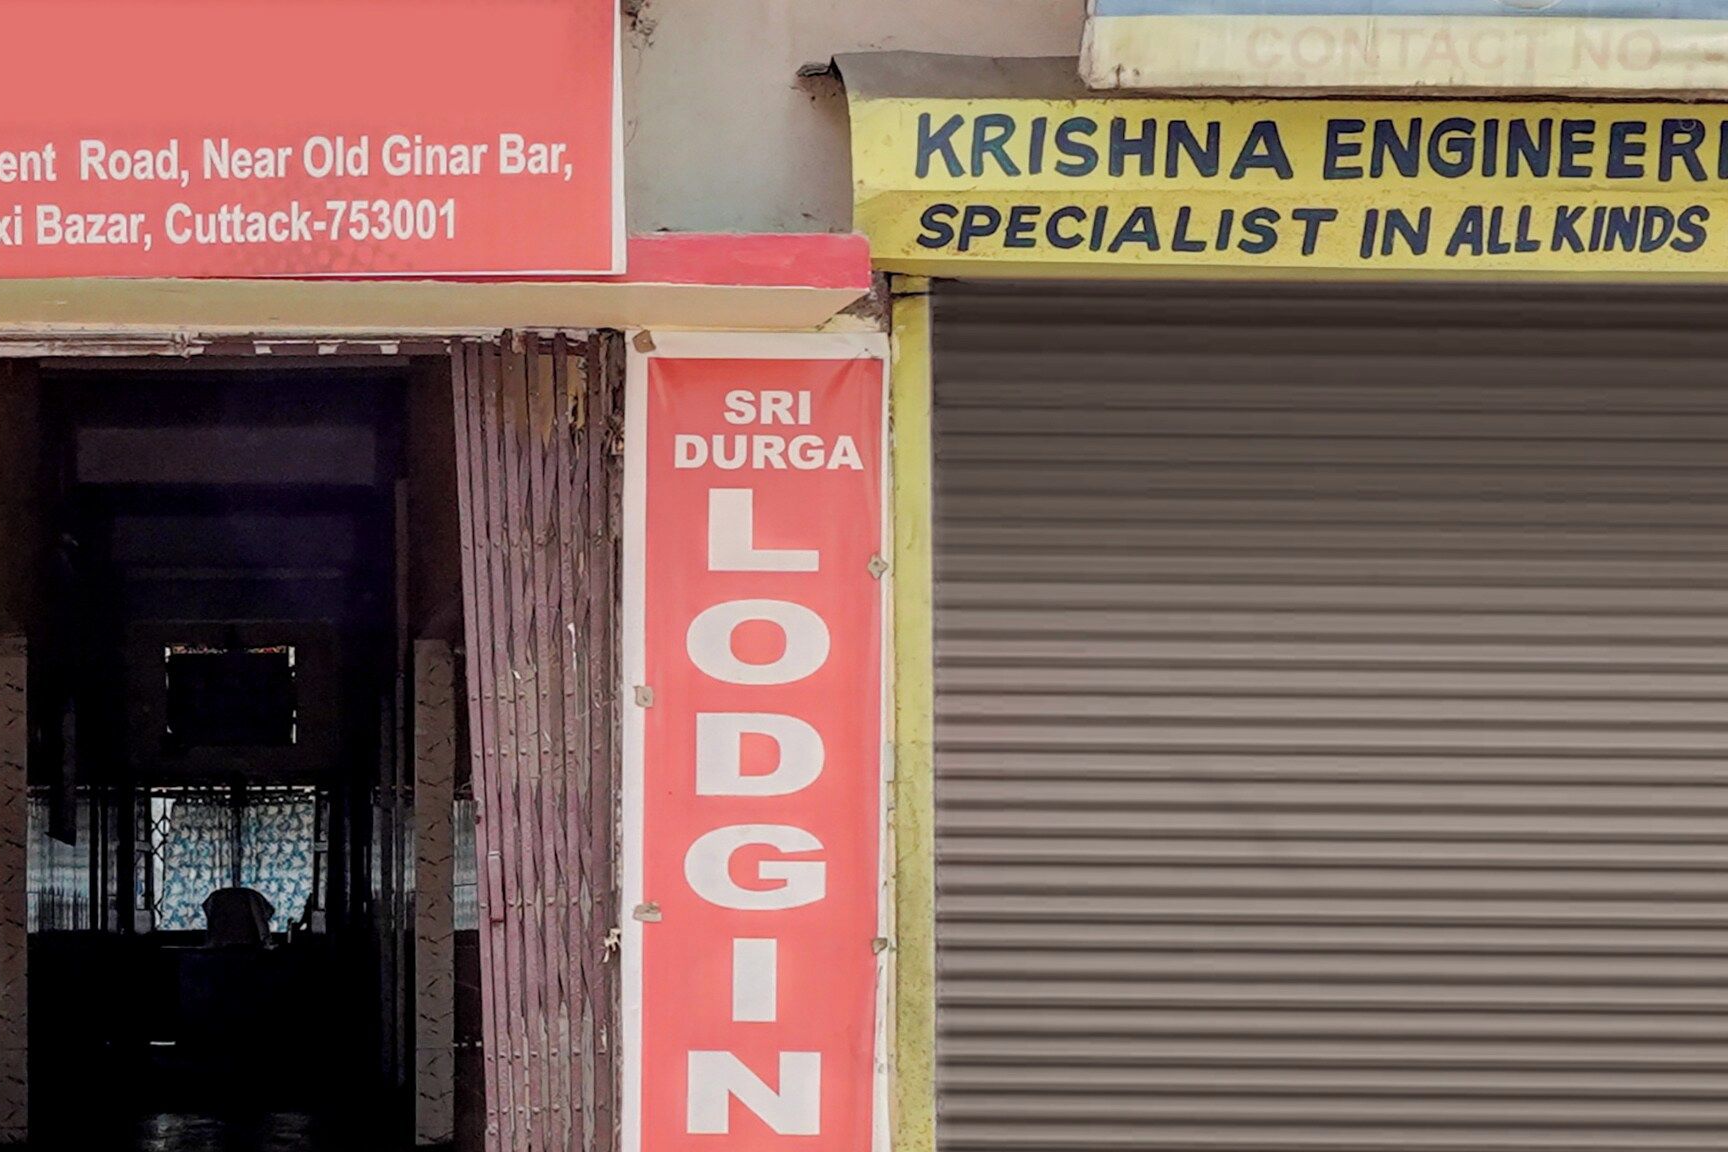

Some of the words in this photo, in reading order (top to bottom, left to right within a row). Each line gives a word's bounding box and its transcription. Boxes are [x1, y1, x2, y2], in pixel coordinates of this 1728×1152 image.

[1245, 25, 1548, 70] CONTACT
[79, 139, 190, 187] Road,
[203, 137, 291, 180] Near
[302, 135, 369, 178] Old
[381, 133, 487, 176] Ginar
[498, 133, 573, 182] Bar,
[914, 112, 1294, 180] KRISHNA
[36, 203, 152, 251] Bazar,
[164, 198, 456, 245] Cuttack-753001
[915, 203, 1339, 256] SPECIALIST
[1359, 207, 1432, 259] IN
[1445, 205, 1542, 257] ALL
[1550, 204, 1710, 253] KINDS
[723, 388, 812, 426] SRI
[674, 434, 865, 471] DURGA
